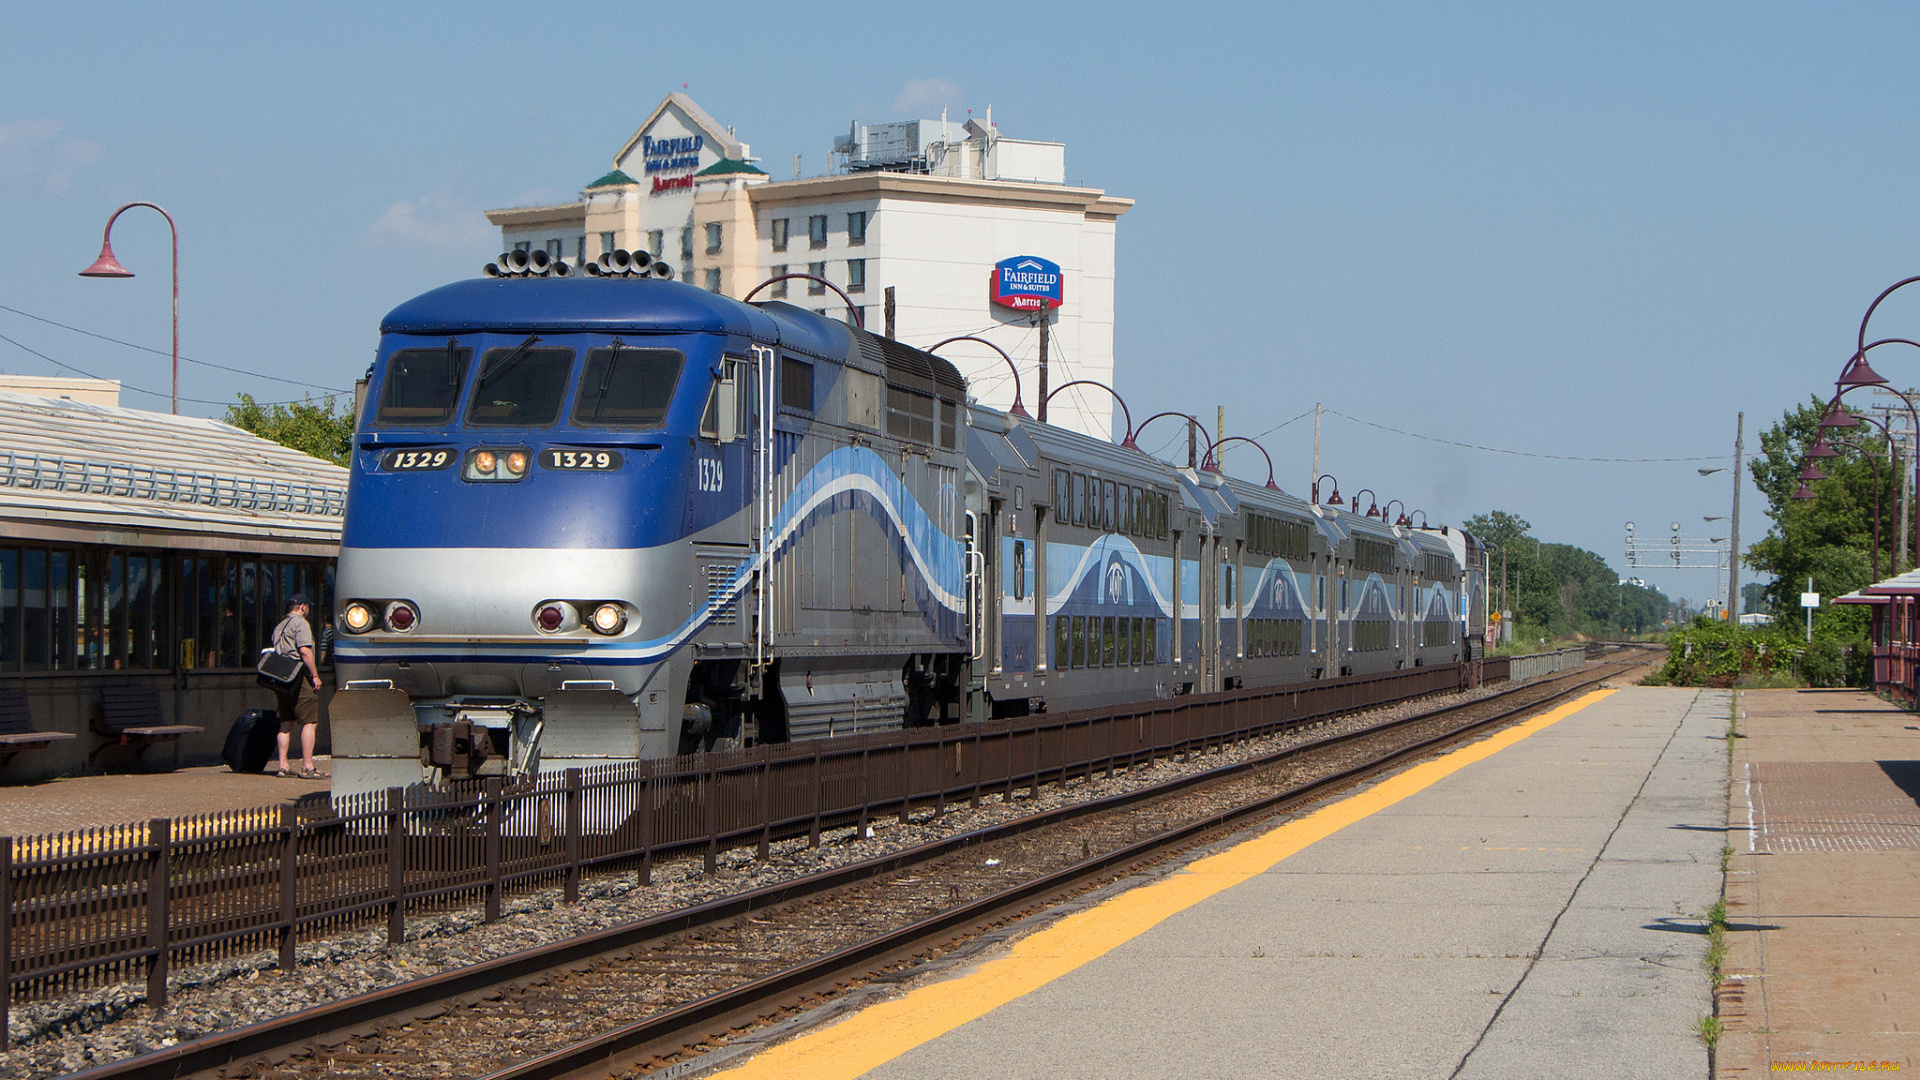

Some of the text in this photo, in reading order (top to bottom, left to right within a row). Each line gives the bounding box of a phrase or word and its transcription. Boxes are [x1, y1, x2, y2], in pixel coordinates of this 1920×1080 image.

[643, 135, 703, 156] FAIRFIELD
[1004, 268, 1057, 284] FAIRFIELD
[1012, 297, 1042, 307] Marrio
[393, 452, 447, 468] 1329
[552, 452, 610, 468] 1329
[698, 458, 723, 492] 1329
